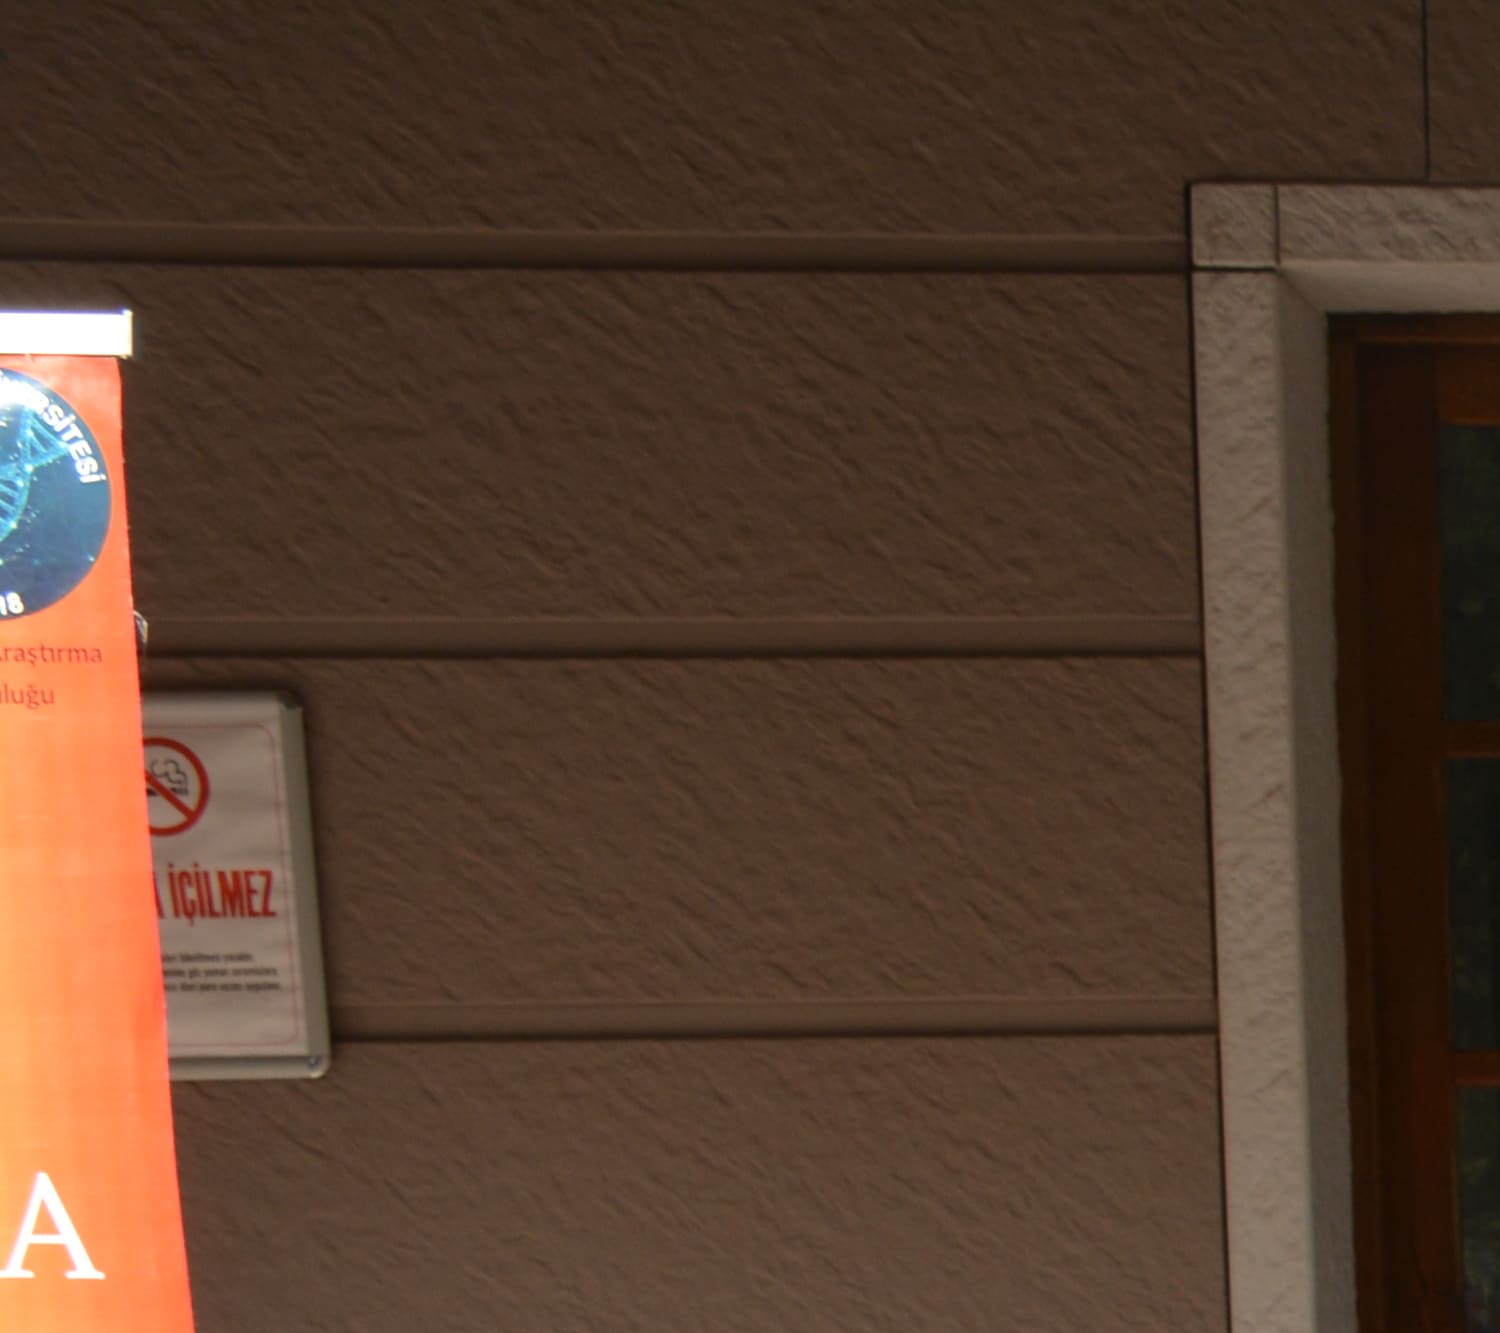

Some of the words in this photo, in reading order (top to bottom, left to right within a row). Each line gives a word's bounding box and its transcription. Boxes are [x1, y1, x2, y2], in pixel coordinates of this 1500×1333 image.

[0, 642, 103, 668] raştırma
[0, 683, 55, 710] luğu
[168, 862, 277, 927] İÇİLMEZ
